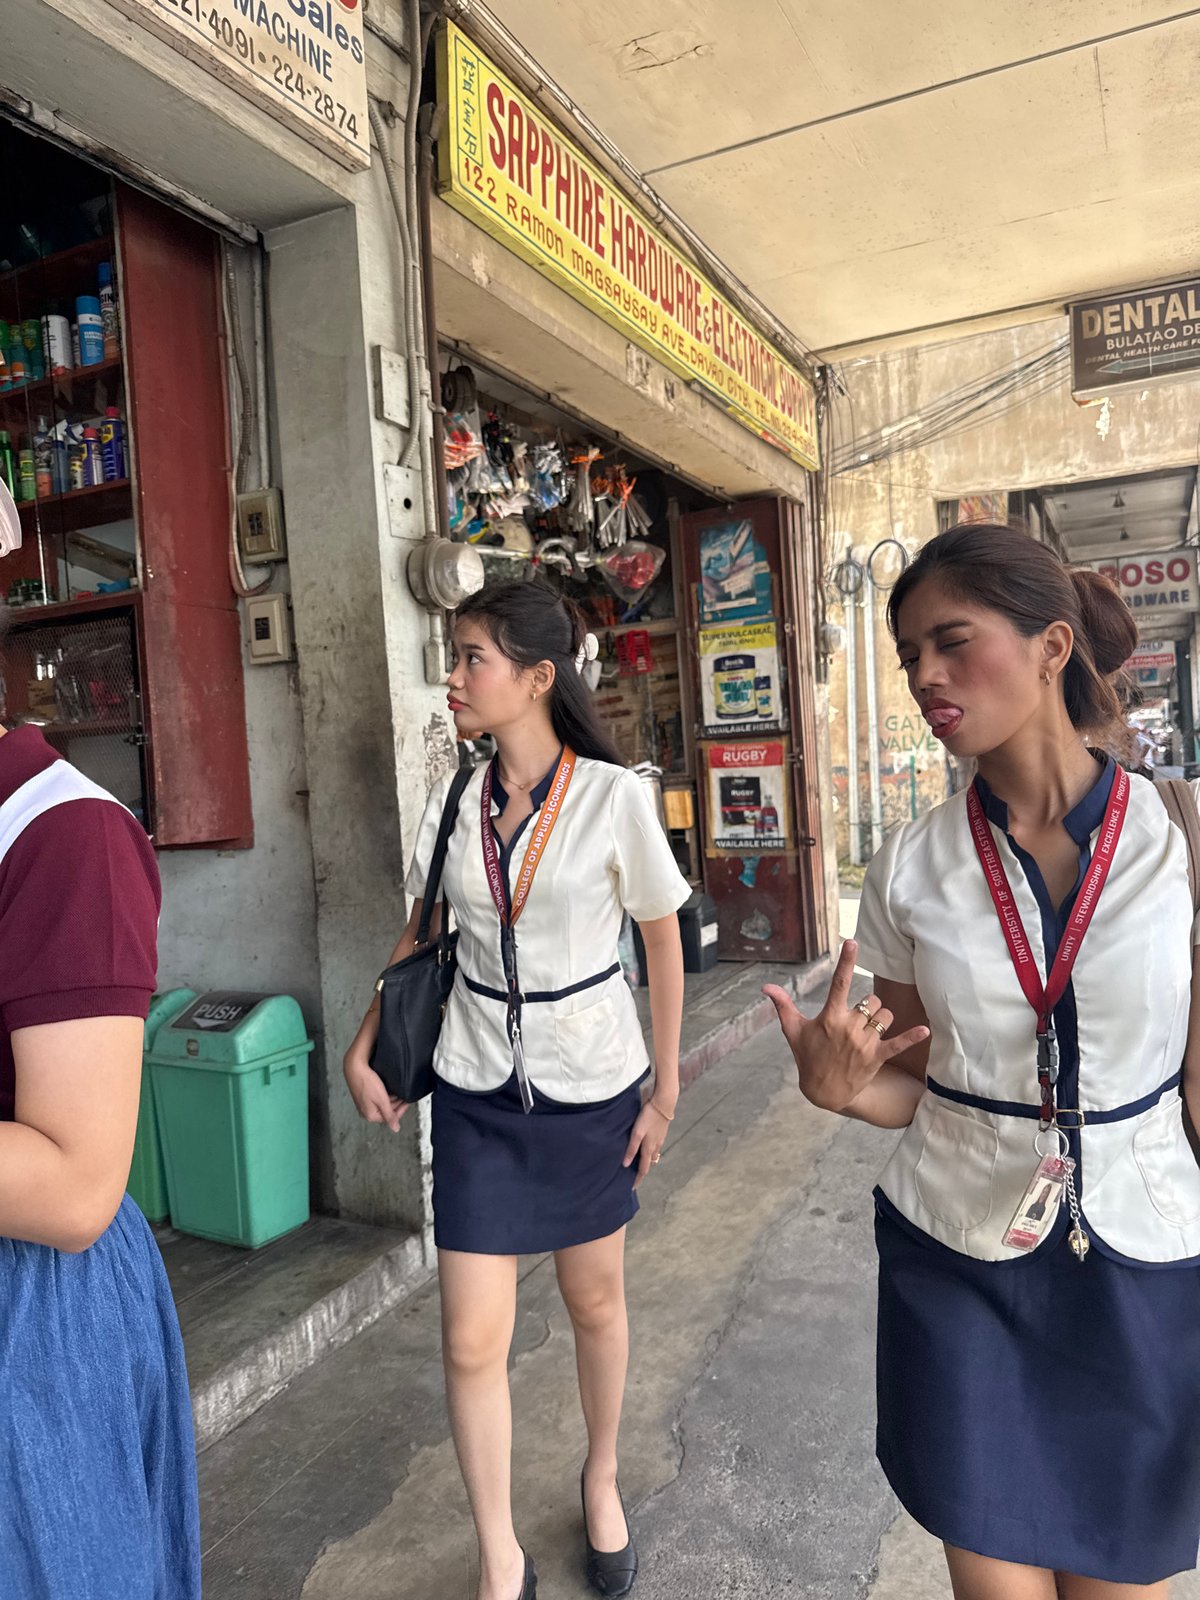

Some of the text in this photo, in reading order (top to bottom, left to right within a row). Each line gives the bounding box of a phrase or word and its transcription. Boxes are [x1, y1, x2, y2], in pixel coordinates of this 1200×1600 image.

[168, 0, 359, 139] 21-4091 224-2874
[464, 157, 497, 204] 122
[571, 248, 658, 333] MAGSAYSAY
[690, 345, 724, 387] DAVAO
[486, 82, 816, 438] SAPPHIRE HARDWARE & ELECTRICAL SUPPLY
[1081, 289, 1200, 339] DENTAL
[1085, 352, 1120, 364] DENTAL
[1123, 345, 1160, 358] HEALTH
[1162, 339, 1188, 351] CARE
[1106, 328, 1177, 350] BULATAO
[707, 724, 752, 735] AVAILABLE
[885, 714, 923, 732] GAT
[723, 750, 767, 762] RUGBY
[880, 733, 938, 752] VALVE
[516, 762, 571, 907] COLLEGE OF APPLIED ECONOMICS
[716, 839, 784, 848] AVAILABLE HERE
[973, 817, 1003, 887] SOUTHEASTERN
[482, 820, 494, 863] FINANCIAL
[488, 862, 505, 914] ECONOMICS
[1061, 936, 1076, 962] UNITY
[1074, 863, 1102, 925] STEWARDSHIP
[1101, 808, 1121, 854] EXCELLENCE
[996, 890, 1009, 902] OF
[1001, 903, 1029, 964] UNIVERSITY
[193, 1004, 242, 1021] PUSH
